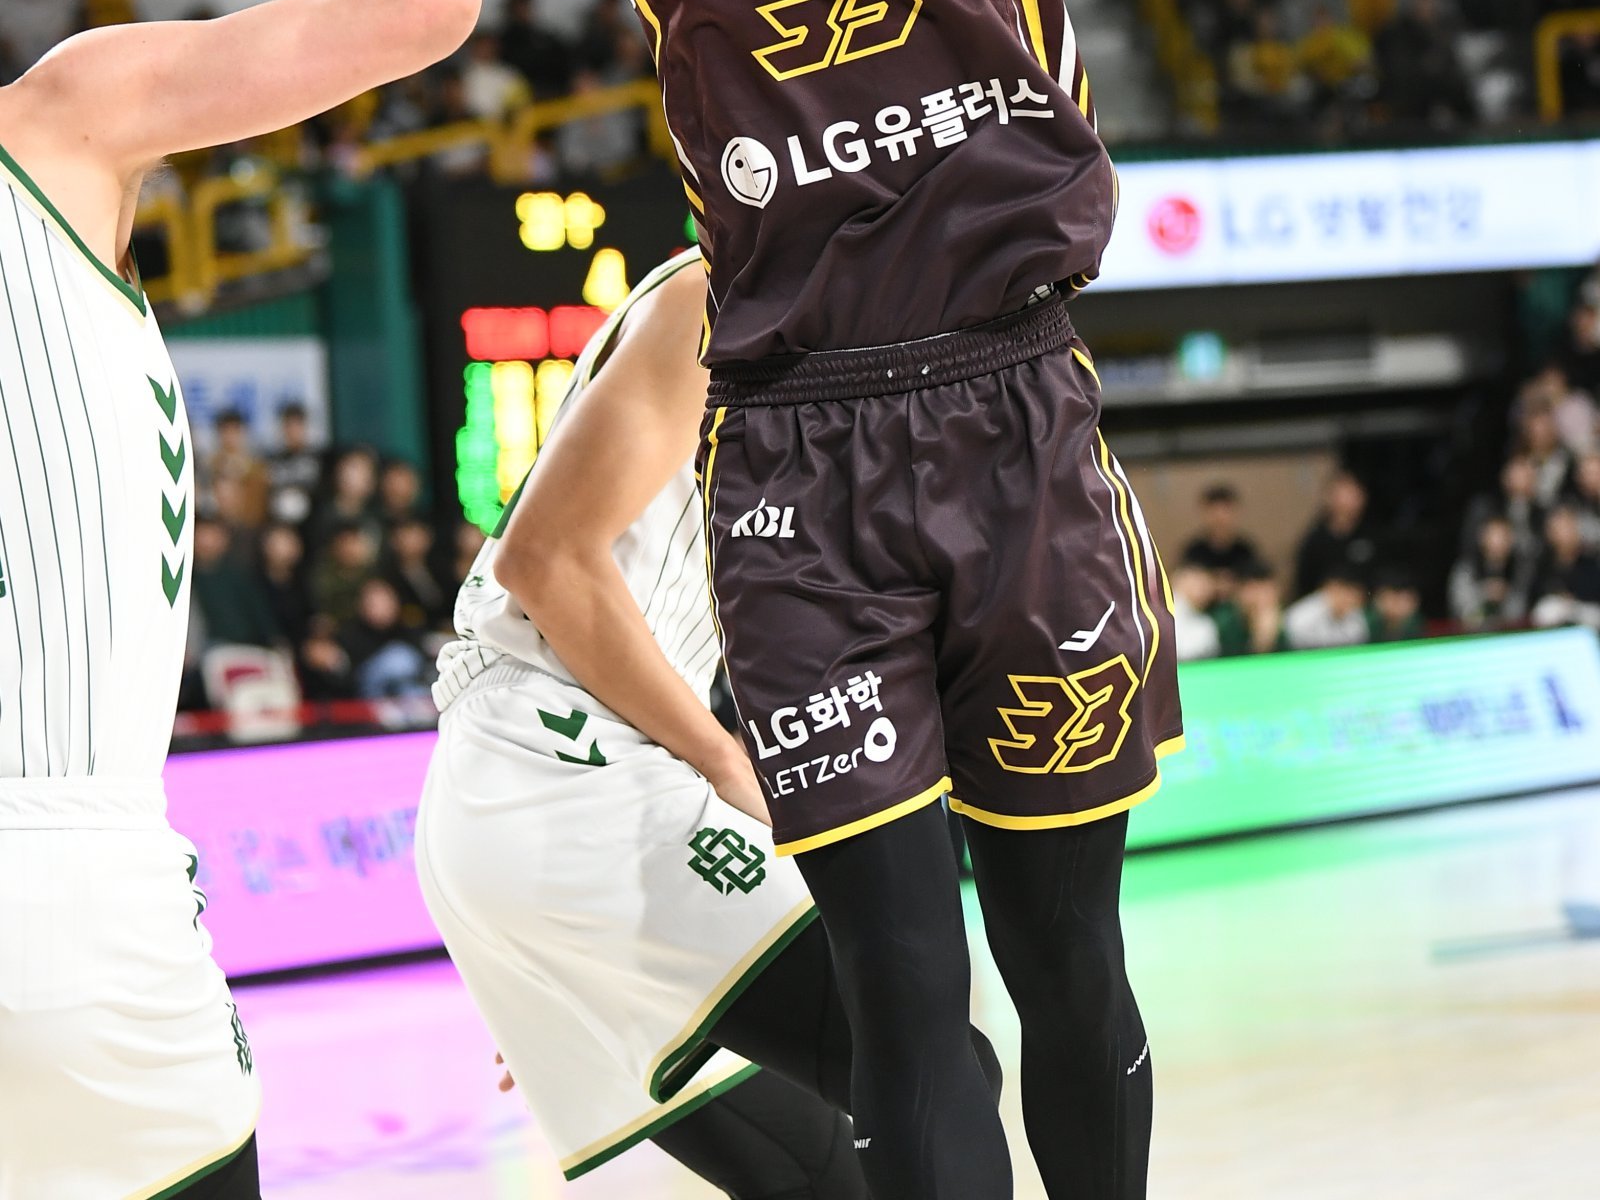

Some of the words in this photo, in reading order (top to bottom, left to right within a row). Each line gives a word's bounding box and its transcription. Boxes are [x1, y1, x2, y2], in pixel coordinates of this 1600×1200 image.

[786, 77, 1055, 187] LG유플러스
[730, 496, 796, 538] KBL
[747, 670, 884, 761] LG화학
[986, 652, 1141, 775] 33
